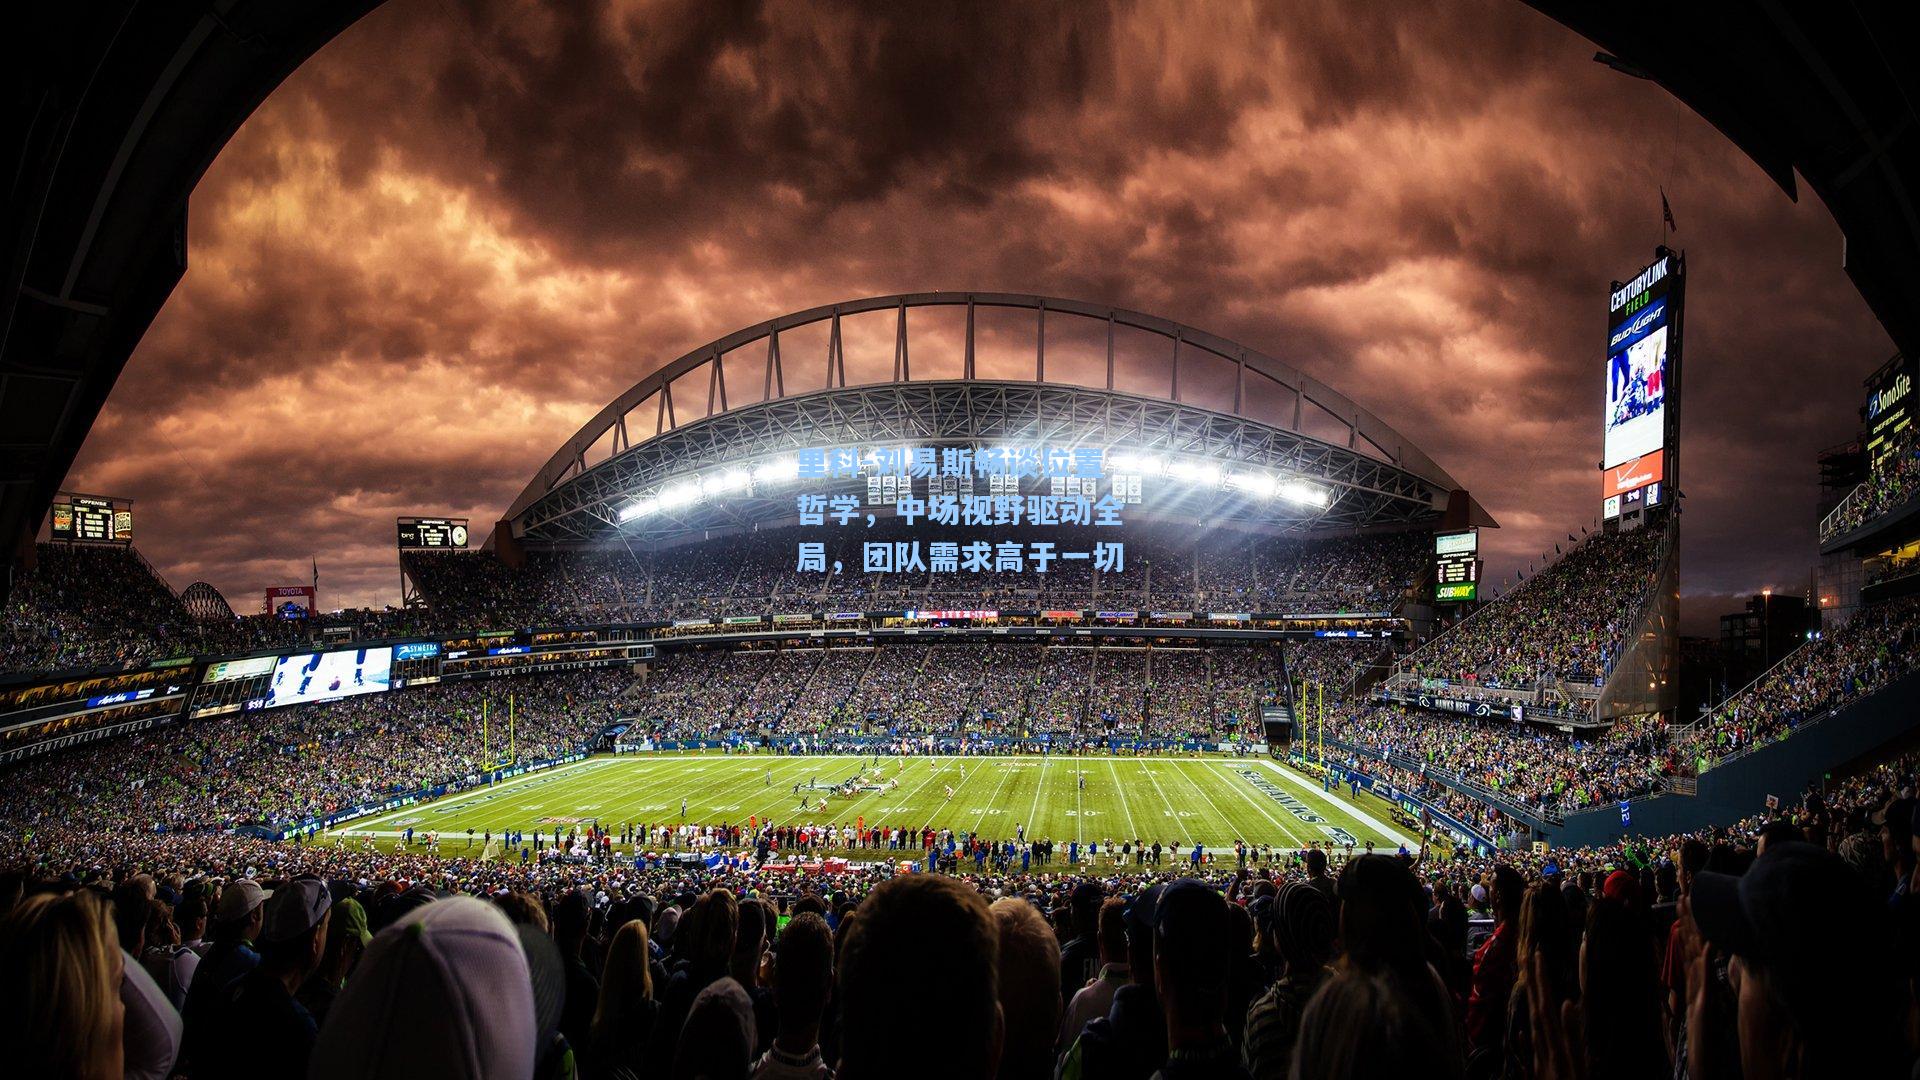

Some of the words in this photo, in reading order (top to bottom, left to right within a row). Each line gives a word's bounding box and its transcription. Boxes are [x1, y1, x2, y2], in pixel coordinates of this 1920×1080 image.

[1610, 256, 1669, 313] CENTURYLINK
[1625, 290, 1650, 316] FIELD
[1610, 326, 1632, 347] BUD
[1633, 305, 1665, 333] LIGHT
[1877, 373, 1911, 414] SonoSite
[1873, 407, 1905, 434] DEFENSE
[1437, 585, 1474, 598] SUBWAY
[410, 644, 437, 652] SYMETRA
[490, 668, 516, 676] HOME
[1435, 699, 1454, 711] HAWKS
[1455, 701, 1470, 712] NEST
[9, 751, 24, 763] TO
[30, 728, 112, 756] CENTURYLINK
[117, 720, 153, 735] FIELD
[1620, 806, 1630, 822] 12
